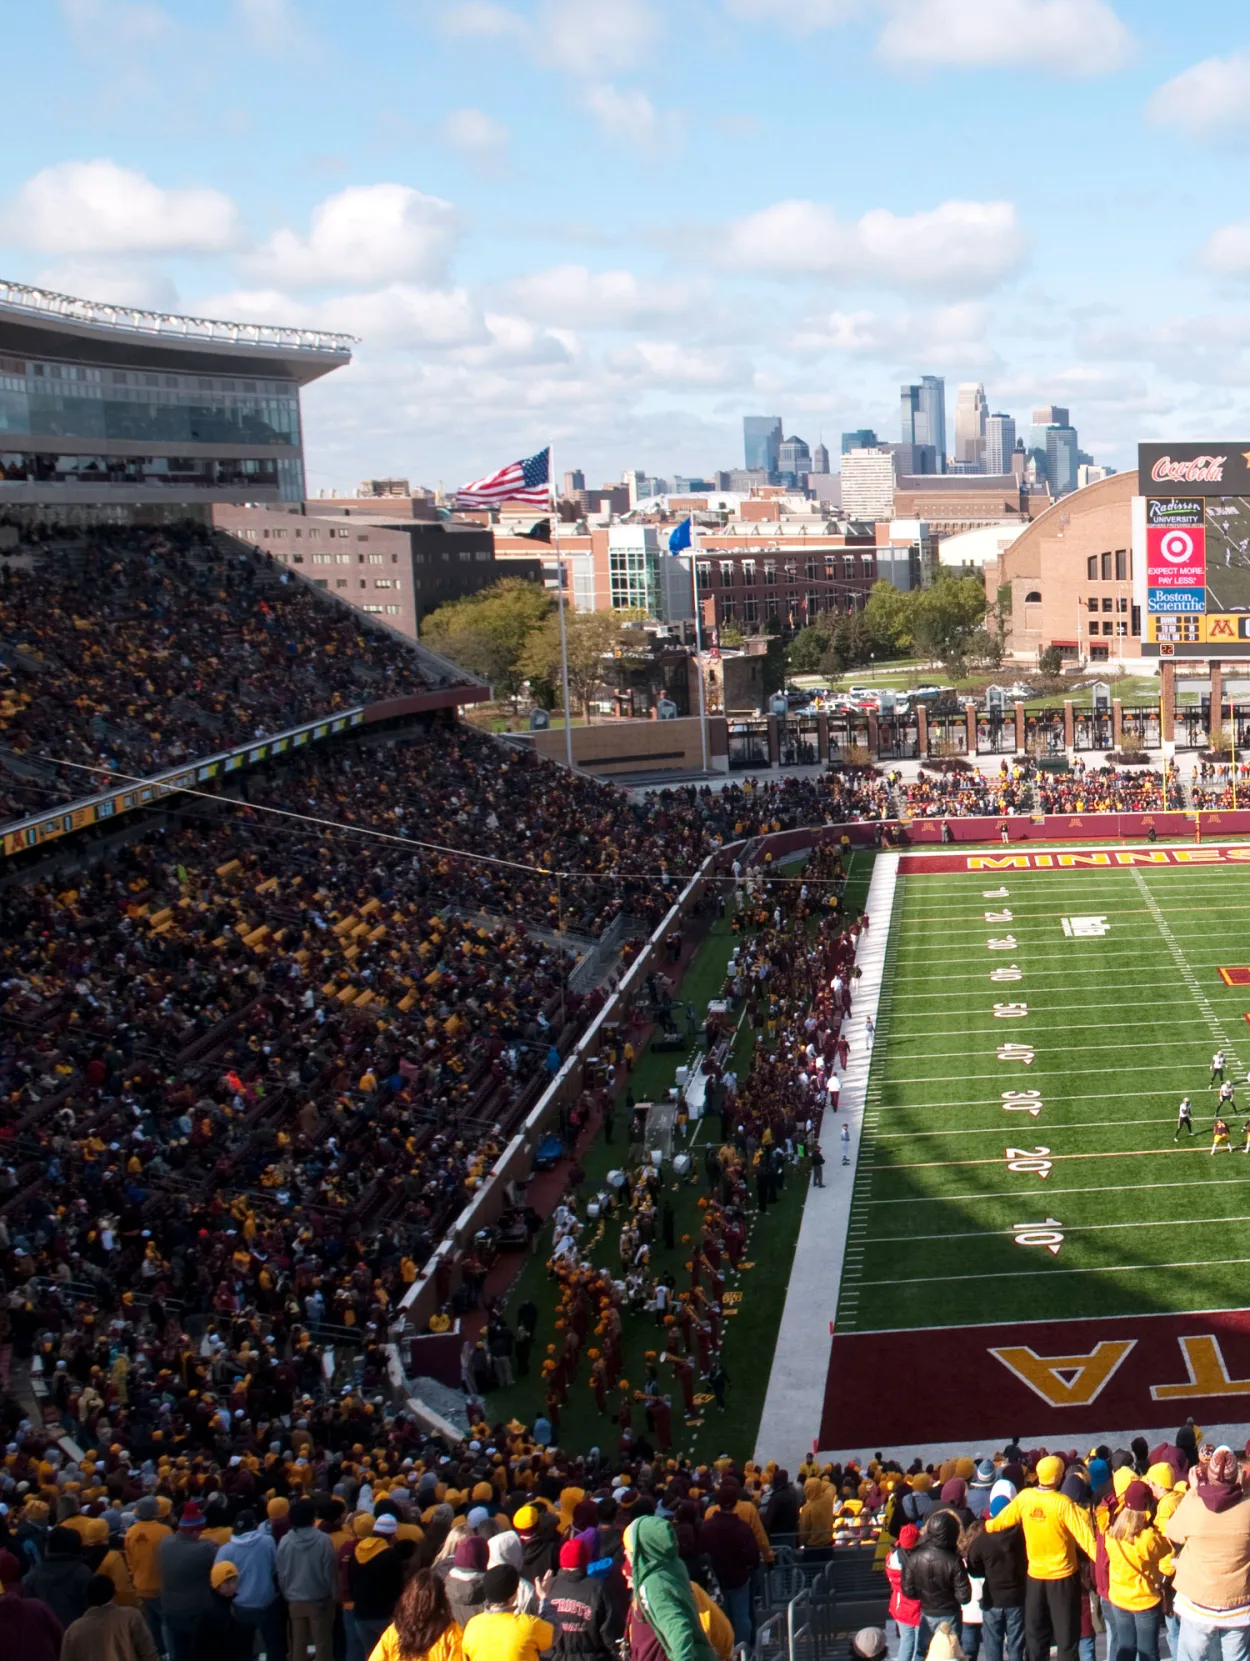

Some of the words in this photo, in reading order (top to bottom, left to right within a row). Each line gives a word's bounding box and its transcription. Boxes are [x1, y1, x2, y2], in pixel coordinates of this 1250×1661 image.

[1151, 456, 1228, 482] Coca-Cola
[1149, 497, 1201, 517] Radisson
[1148, 567, 1178, 575] EXPECT
[1158, 576, 1173, 585] PAY
[1148, 597, 1205, 611] Scientific
[1156, 590, 1192, 602] Boston
[1161, 645, 1174, 655] 22
[993, 1002, 1029, 1018] 50
[996, 1043, 1036, 1060] 40
[1000, 1089, 1043, 1112] 30
[1005, 1146, 1053, 1172] 20
[1012, 1217, 1065, 1246] 10
